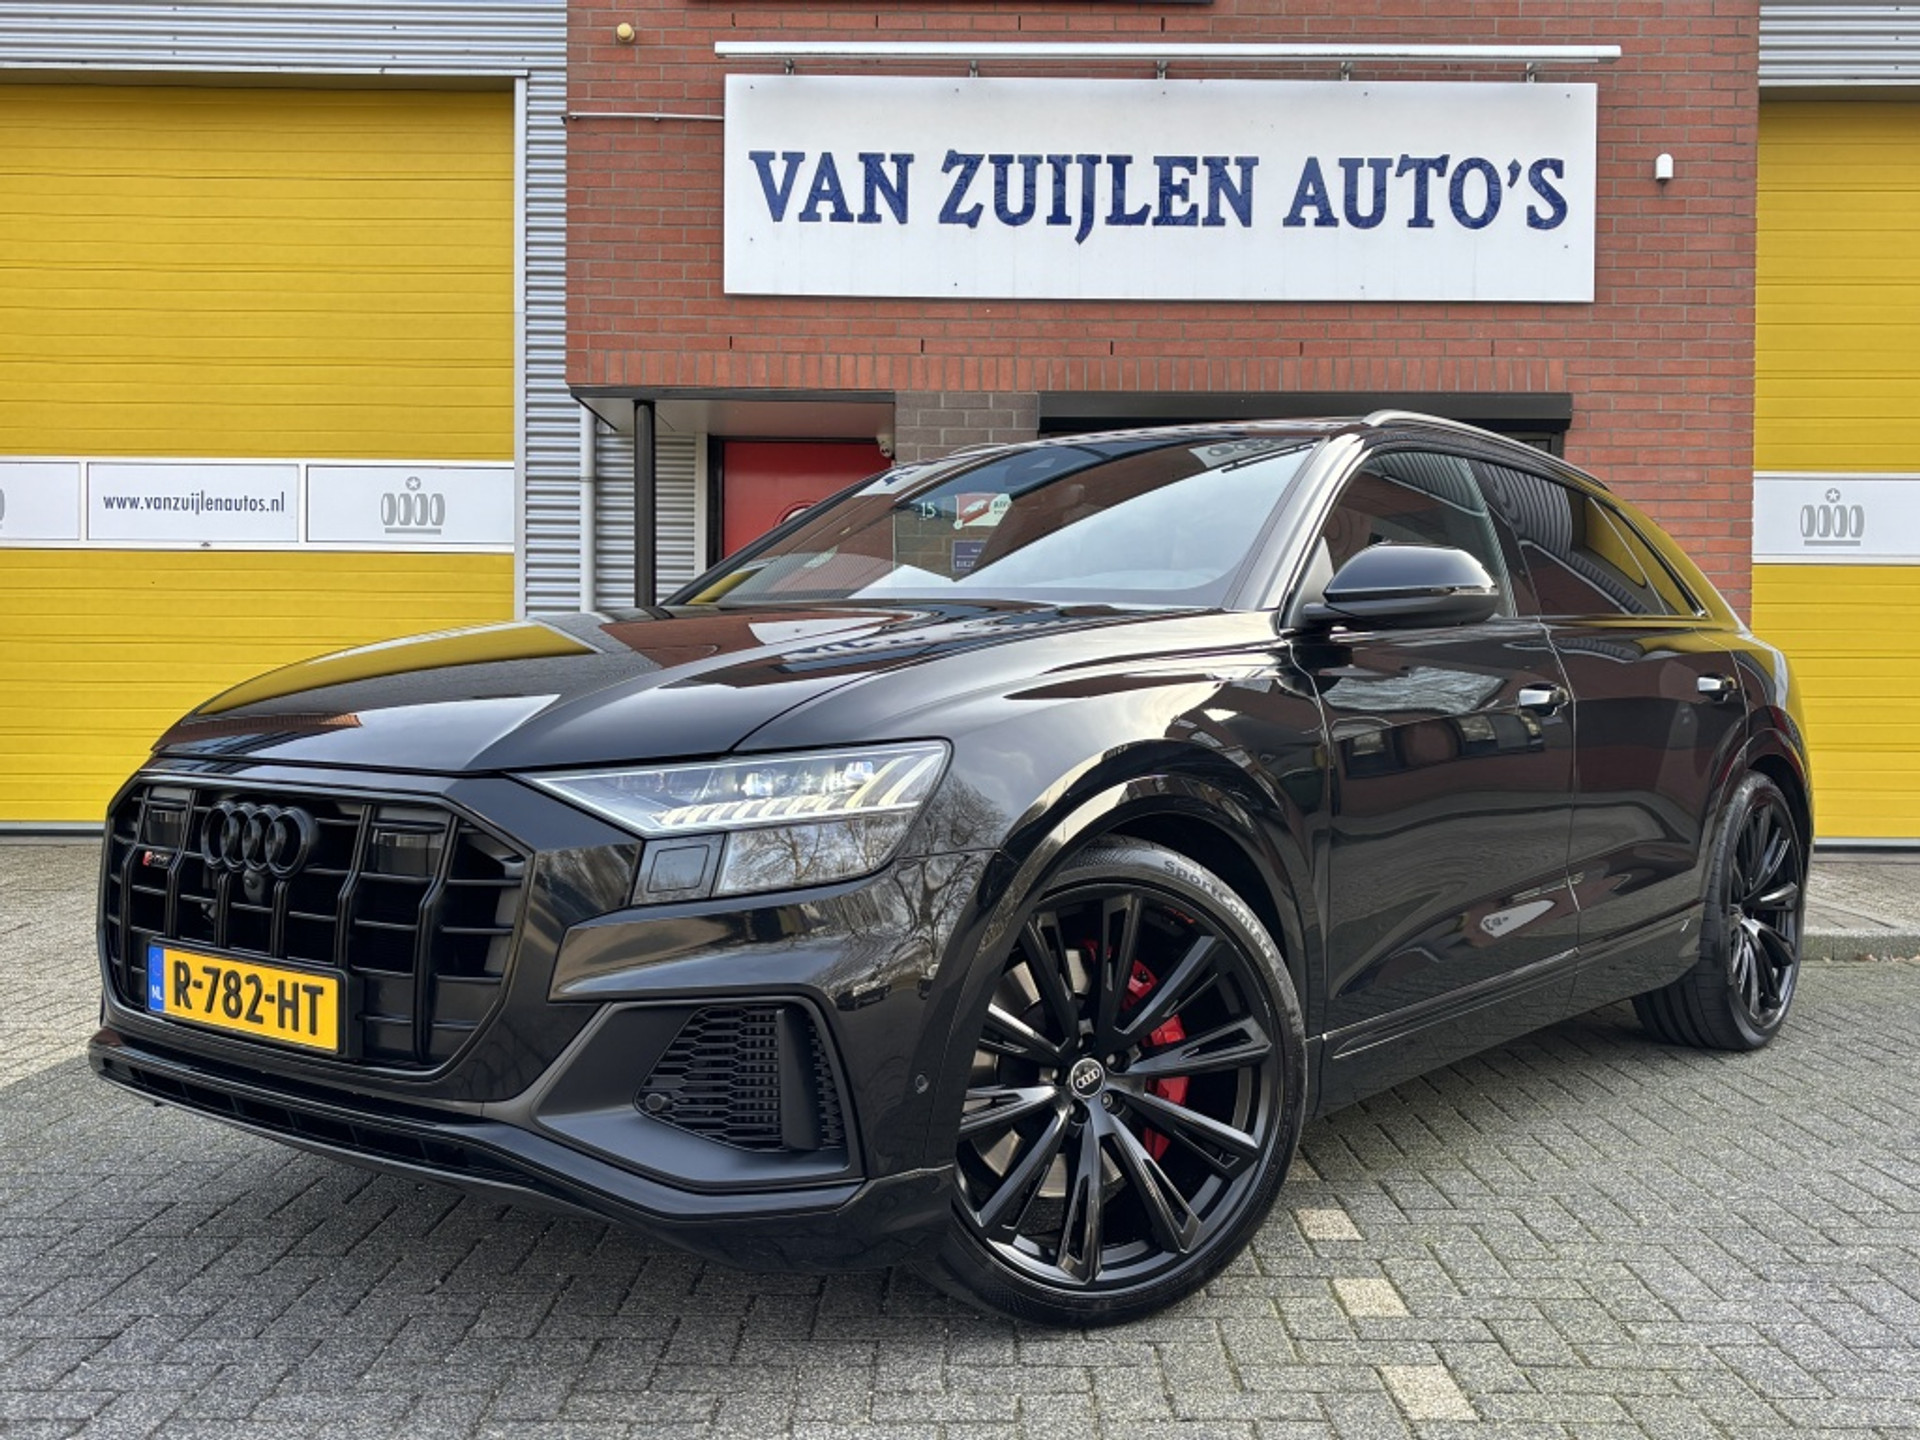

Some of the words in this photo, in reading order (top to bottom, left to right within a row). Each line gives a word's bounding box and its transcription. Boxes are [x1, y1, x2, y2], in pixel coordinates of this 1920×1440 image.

[750, 150, 914, 224] VAN
[939, 150, 1258, 242] ZUIJLEN
[1283, 155, 1567, 229] AUTO'S
[103, 490, 285, 515] www.vanzuijlenautos.nl
[920, 502, 936, 518] 15
[151, 984, 163, 1001] NL
[173, 960, 324, 1036] R-782-HT
